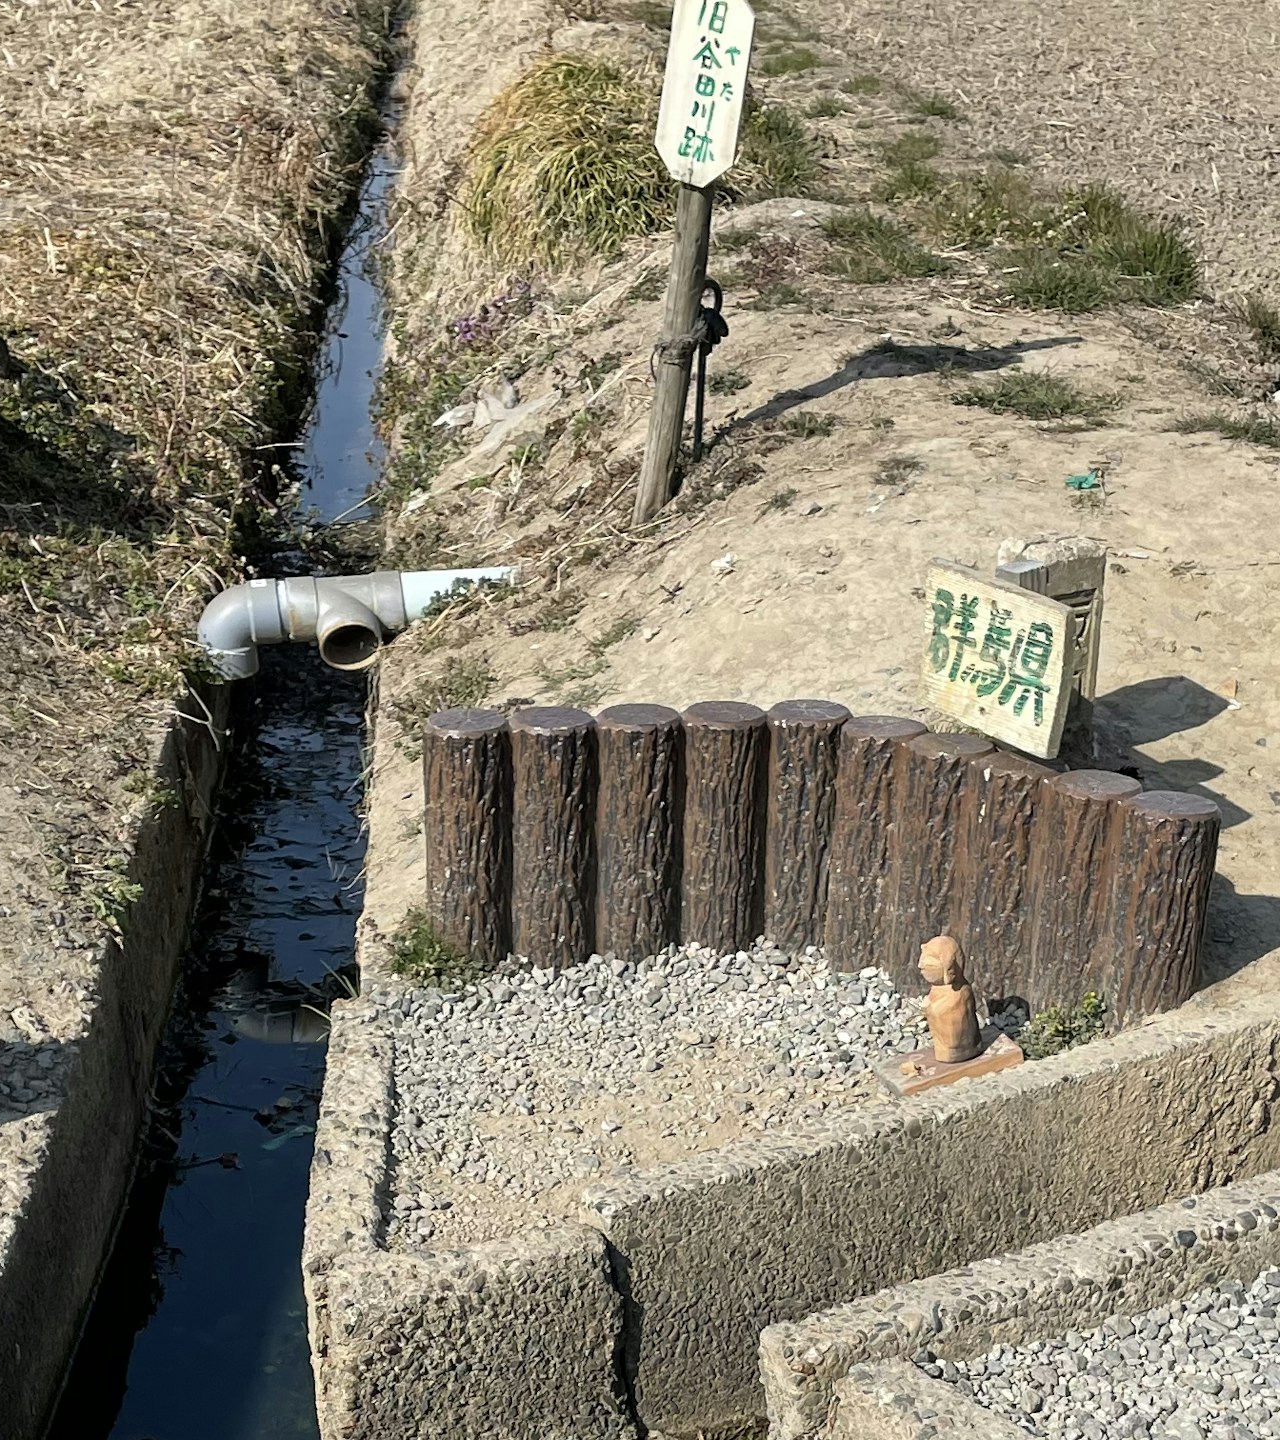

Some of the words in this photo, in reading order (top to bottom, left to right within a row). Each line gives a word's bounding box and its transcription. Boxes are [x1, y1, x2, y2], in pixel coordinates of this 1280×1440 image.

[677, 0, 729, 163] 旧谷田川跡
[720, 46, 741, 102] やた
[928, 587, 1054, 727] 群馬県
